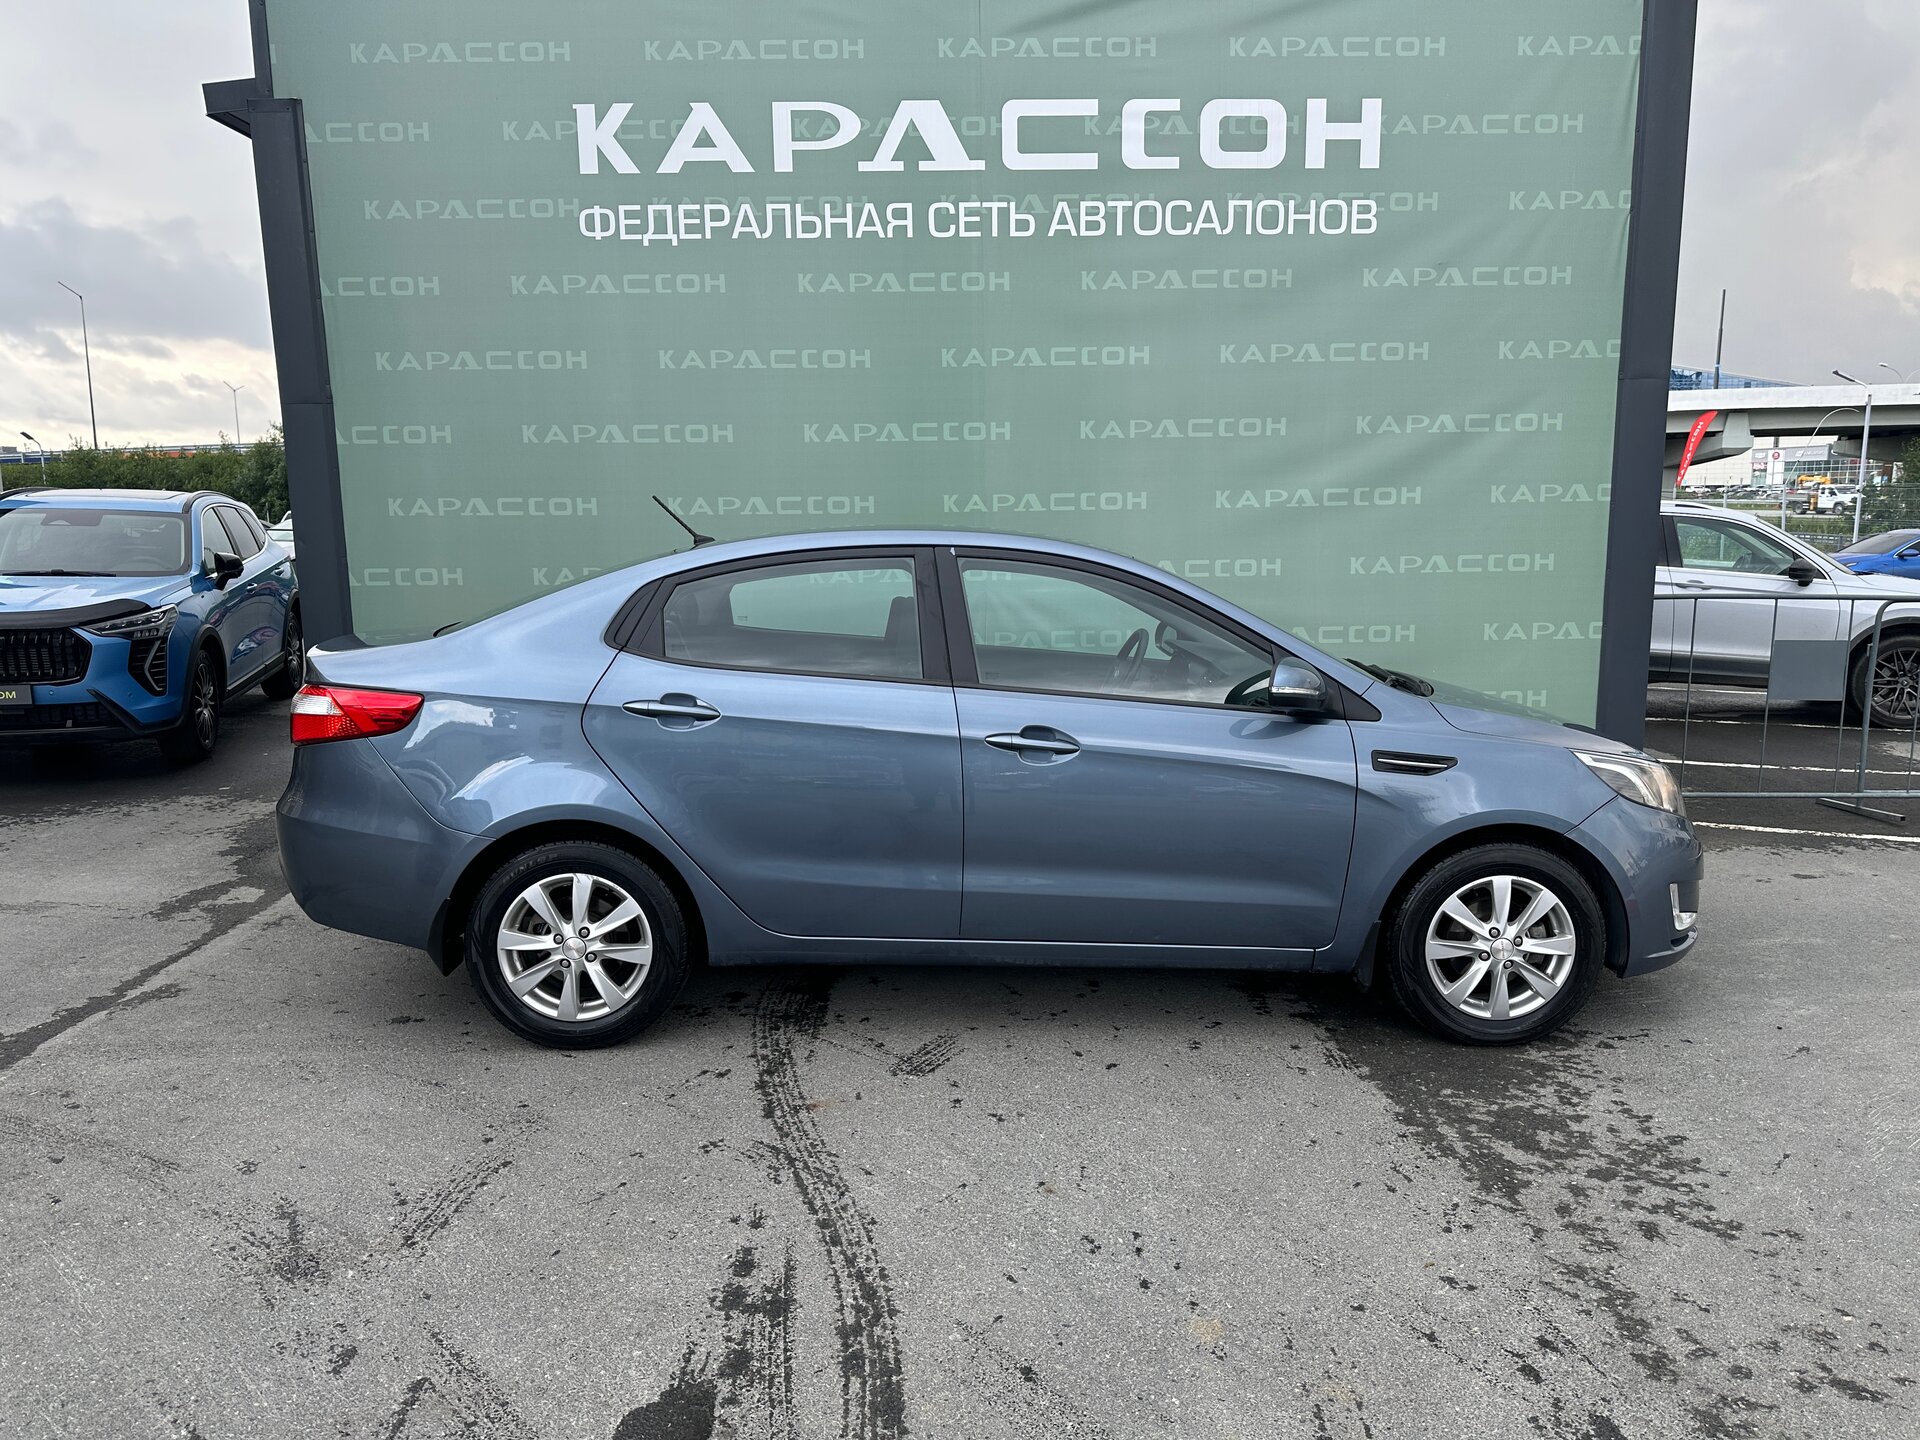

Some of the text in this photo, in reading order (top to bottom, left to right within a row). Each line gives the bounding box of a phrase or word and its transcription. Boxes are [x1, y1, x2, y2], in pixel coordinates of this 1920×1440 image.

[579, 198, 1378, 247] ФЕДЕРАЛЬНАЯ СЕТЬ АВТОСАЛОНОВ
